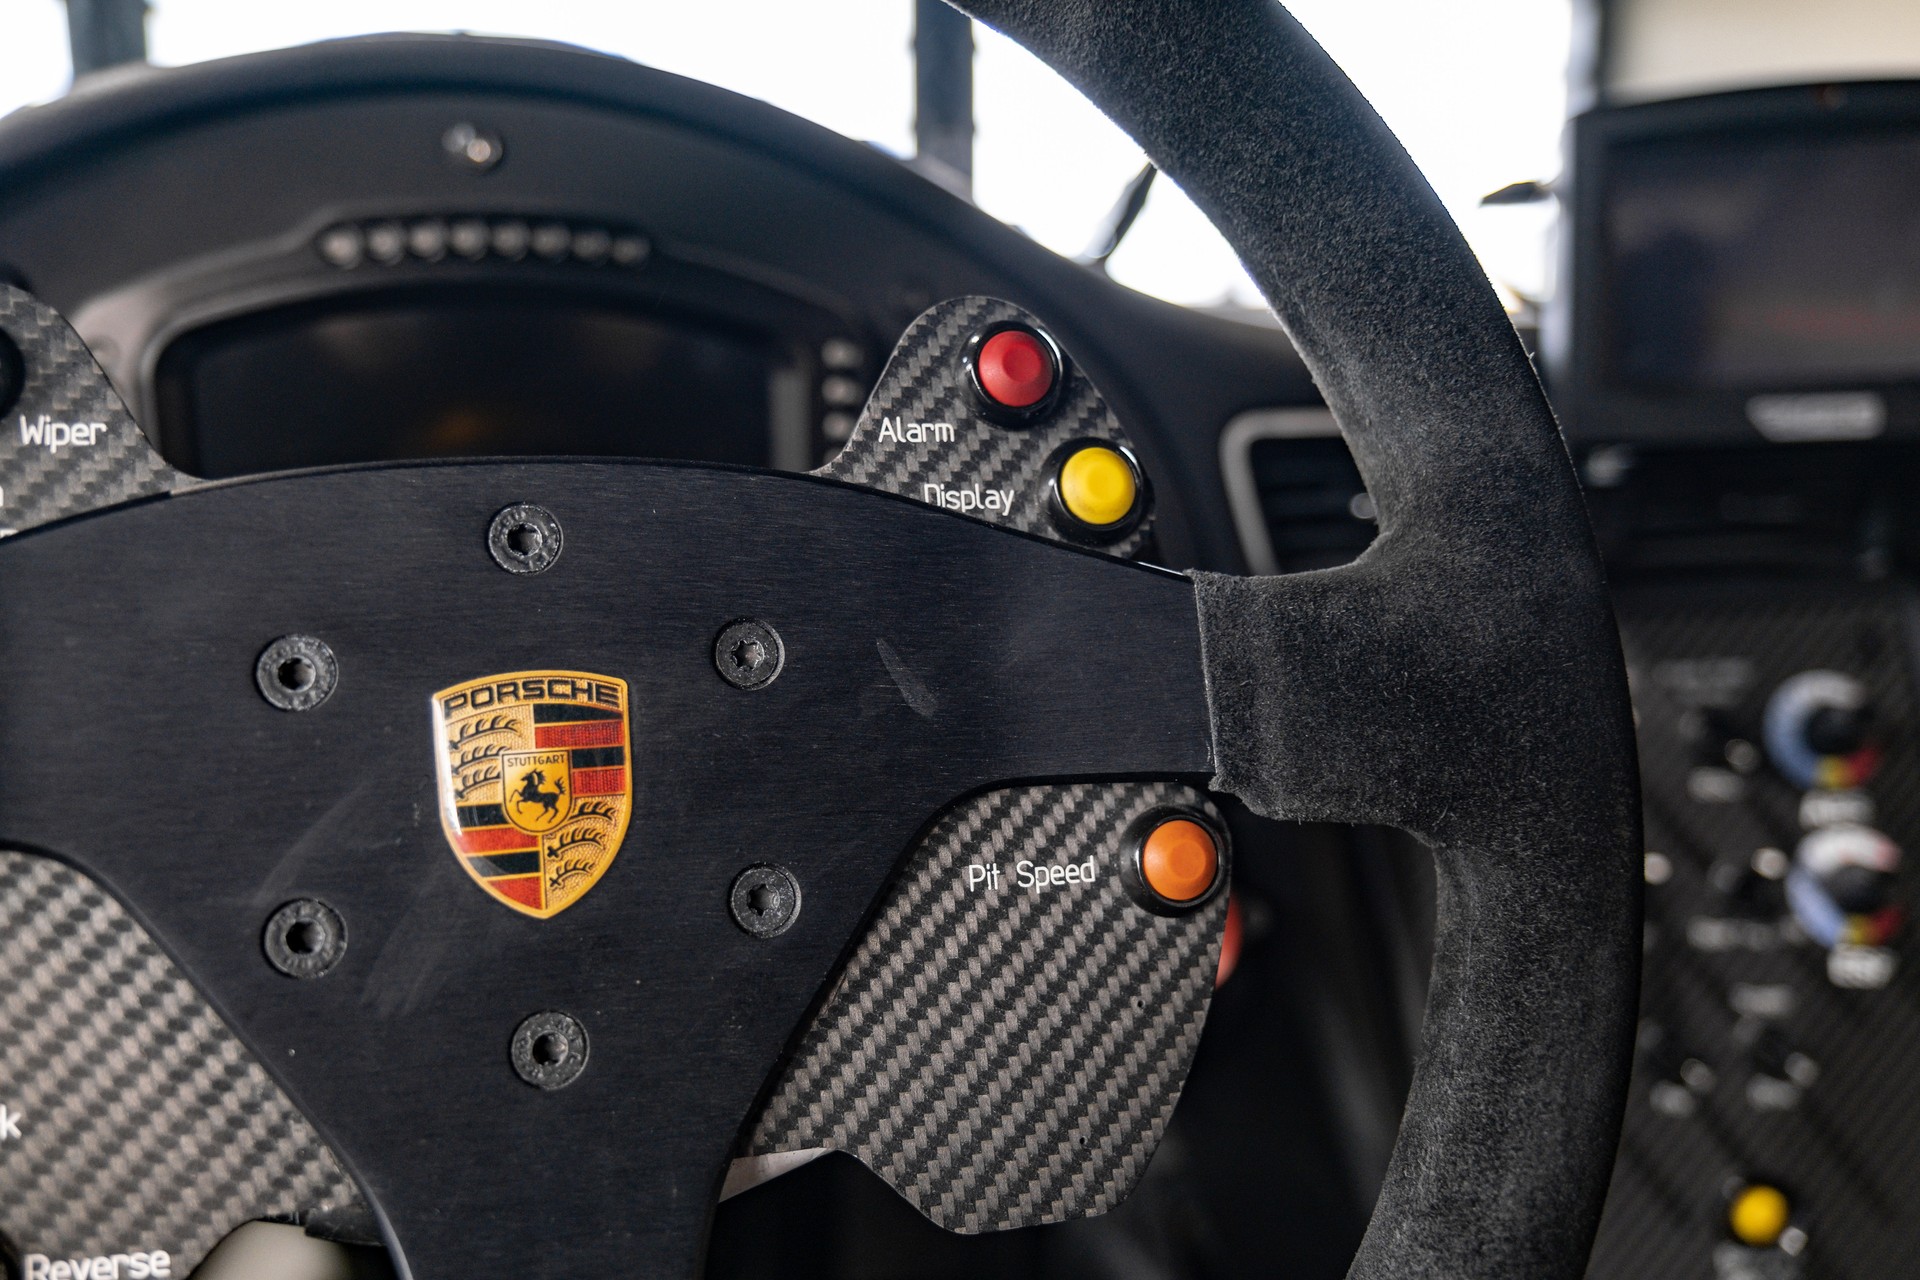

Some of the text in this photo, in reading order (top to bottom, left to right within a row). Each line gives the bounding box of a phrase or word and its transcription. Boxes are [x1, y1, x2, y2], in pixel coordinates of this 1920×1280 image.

[19, 414, 108, 454] Wiper
[878, 416, 955, 443] Alarm
[923, 483, 1015, 516] Display
[443, 679, 620, 719] PORSCHE
[507, 753, 567, 768] STUTTGART
[968, 855, 1096, 894] Pit Speed
[23, 1249, 172, 1280] Reverse
